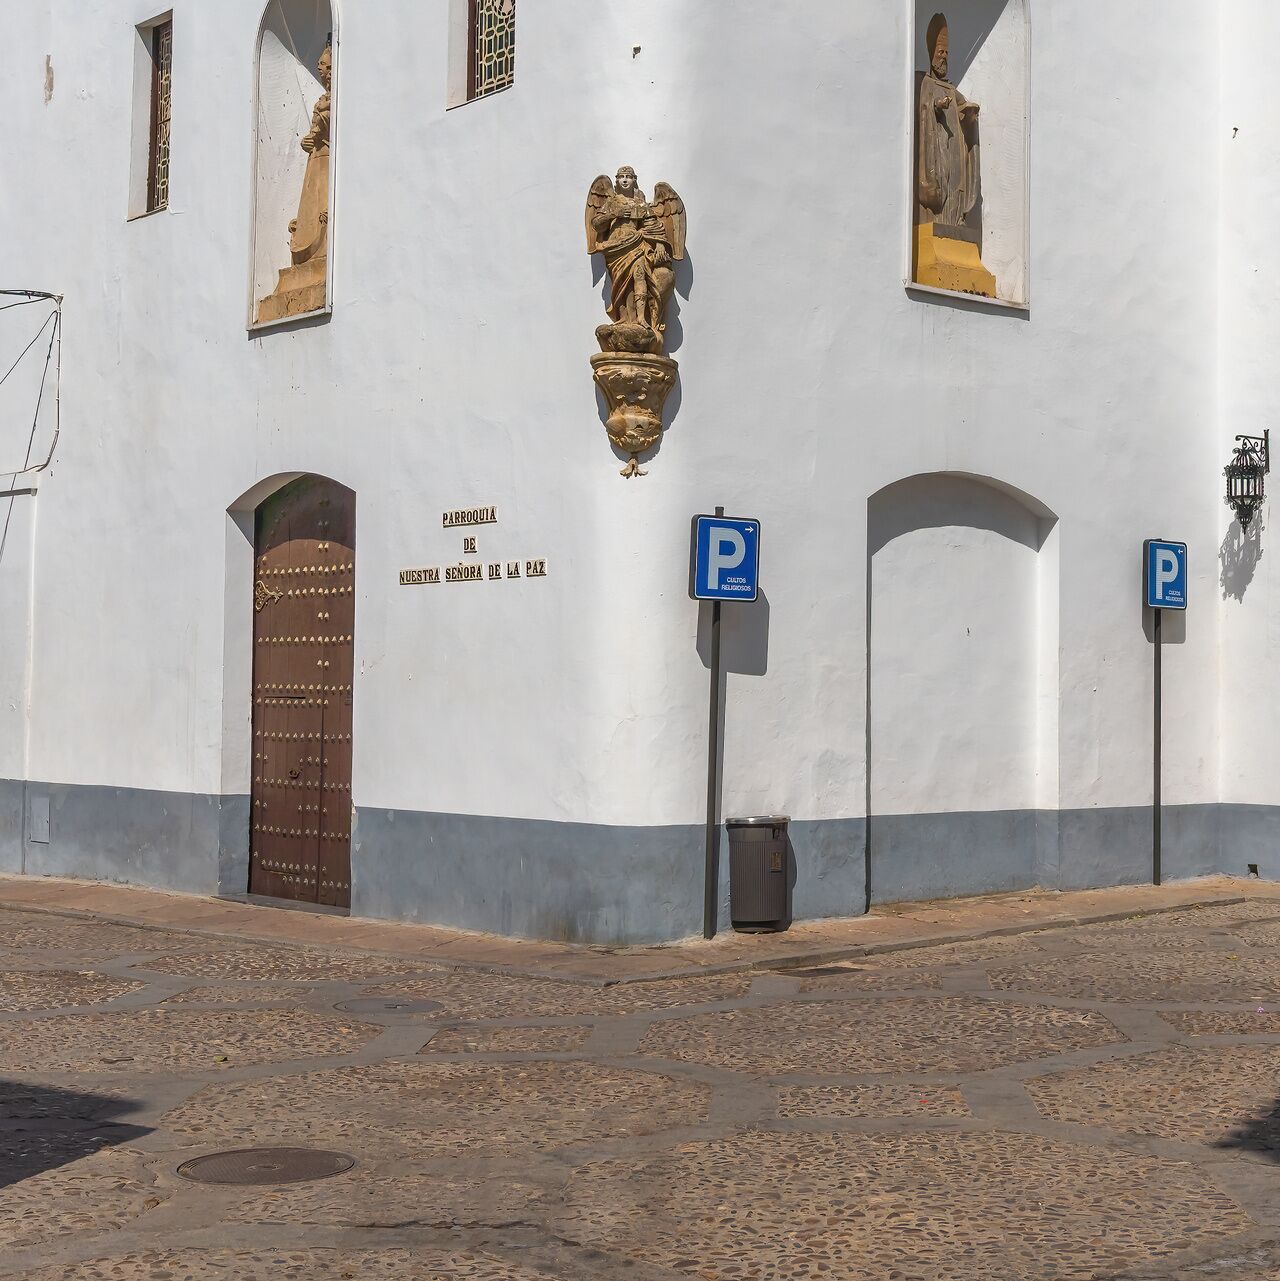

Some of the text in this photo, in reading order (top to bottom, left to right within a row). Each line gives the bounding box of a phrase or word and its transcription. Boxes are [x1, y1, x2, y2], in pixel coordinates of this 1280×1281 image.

[443, 508, 496, 525] PARROQUIA
[464, 538, 476, 551] DE
[708, 527, 746, 589] P
[400, 561, 546, 583] NUESTRA SEÑORA DE LA PAZ
[1156, 549, 1178, 599] P
